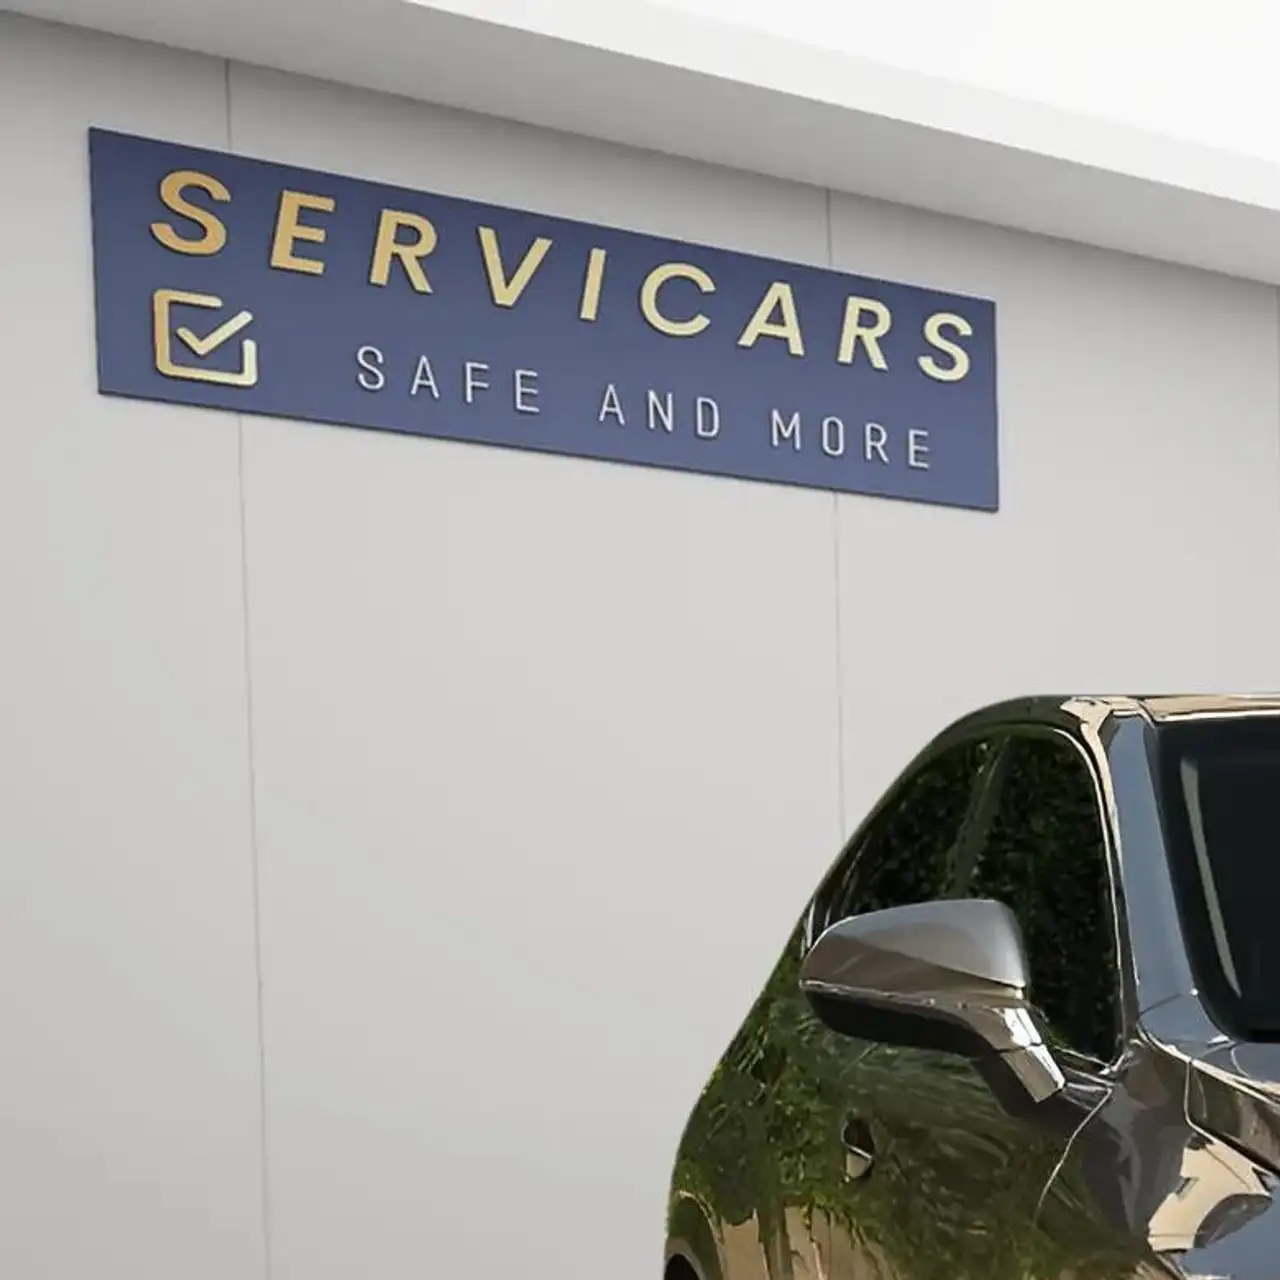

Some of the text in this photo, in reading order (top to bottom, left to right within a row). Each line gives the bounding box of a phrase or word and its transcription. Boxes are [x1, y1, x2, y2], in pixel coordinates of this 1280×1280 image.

[150, 170, 973, 383] SERVICARS
[355, 345, 931, 470] SAFE AND MORE
